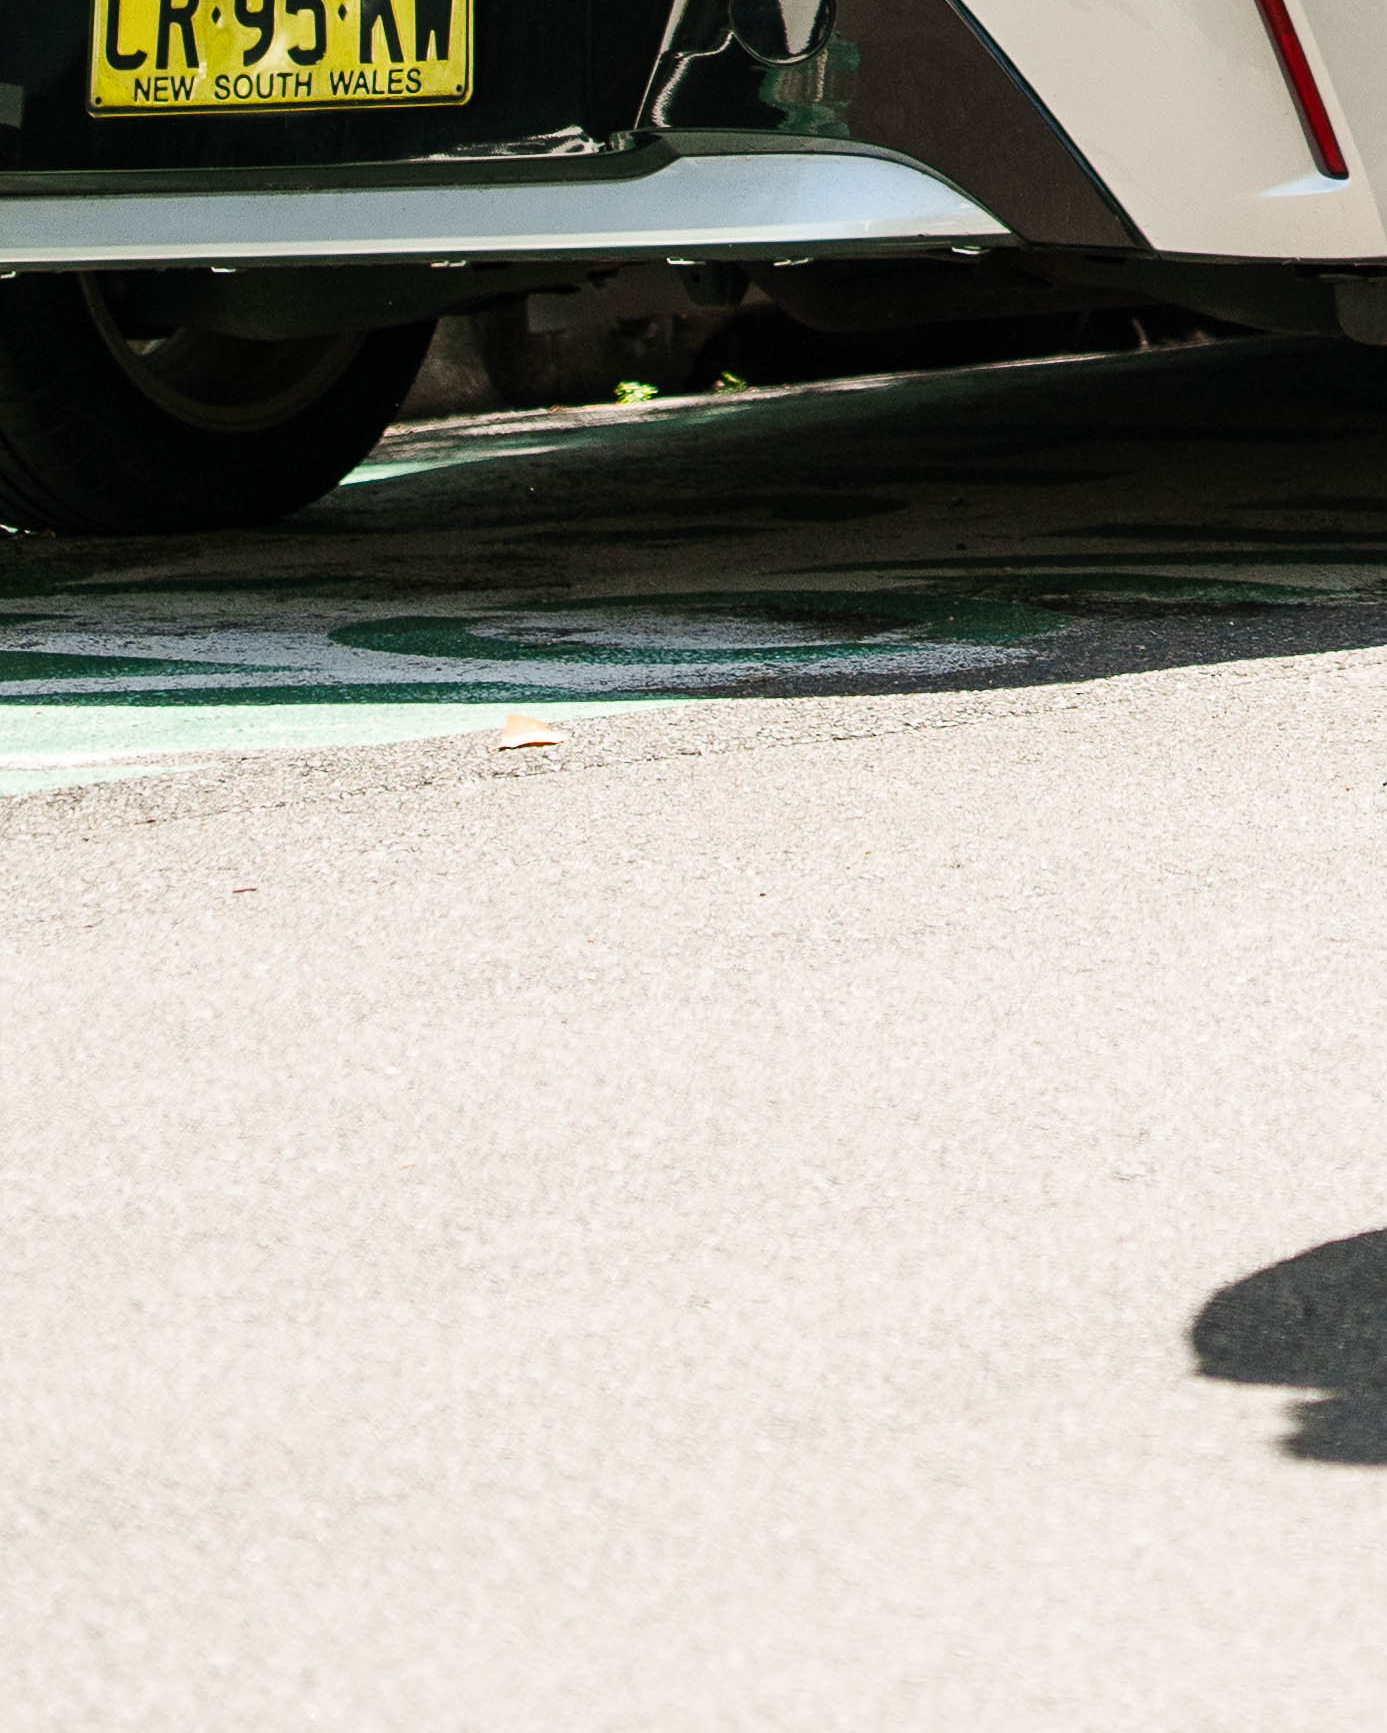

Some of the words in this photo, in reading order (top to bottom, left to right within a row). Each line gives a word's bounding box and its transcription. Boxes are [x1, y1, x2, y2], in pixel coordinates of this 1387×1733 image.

[134, 75, 195, 103] NEW
[214, 71, 313, 100] SOUTH
[329, 68, 423, 97] WALES
